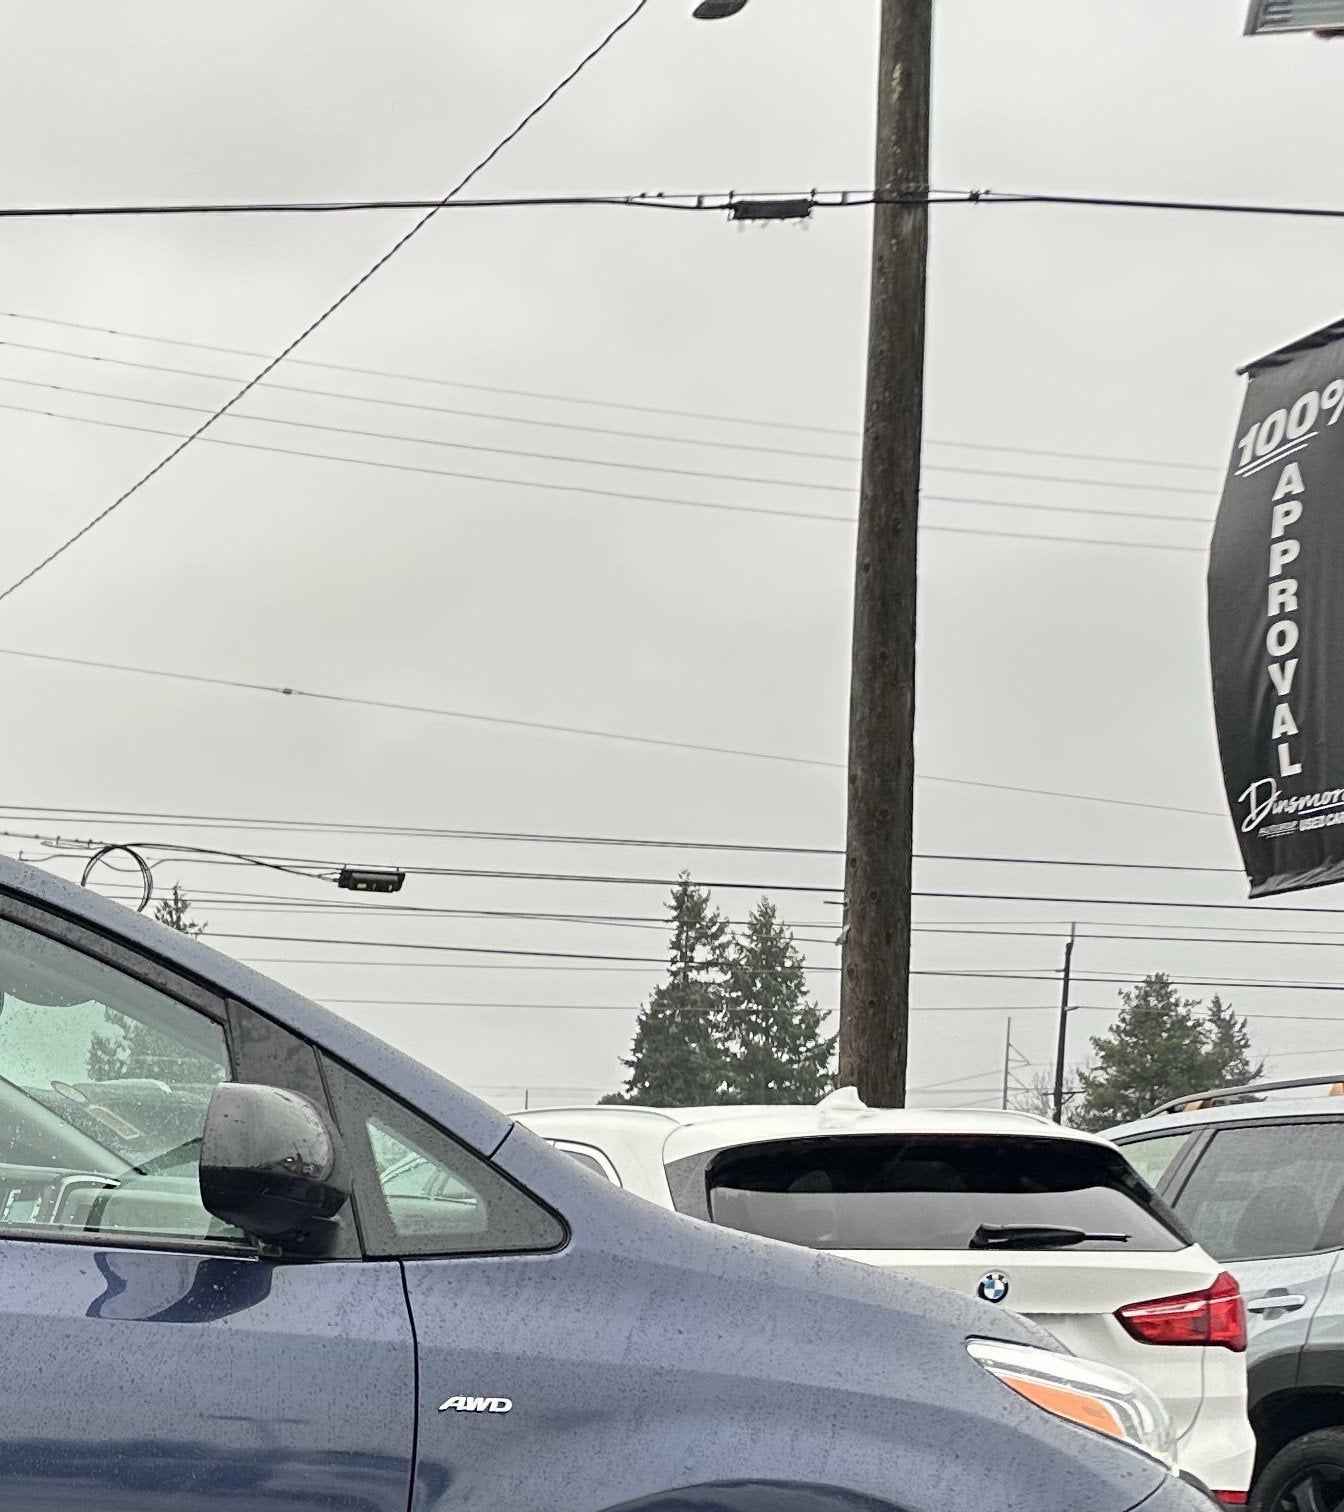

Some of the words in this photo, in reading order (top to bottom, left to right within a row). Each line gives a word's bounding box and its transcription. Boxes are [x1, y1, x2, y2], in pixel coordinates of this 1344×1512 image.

[1266, 461, 1305, 777] APPROVAL
[1238, 778, 1344, 832] Dinsmor
[438, 1396, 512, 1412] AWD
